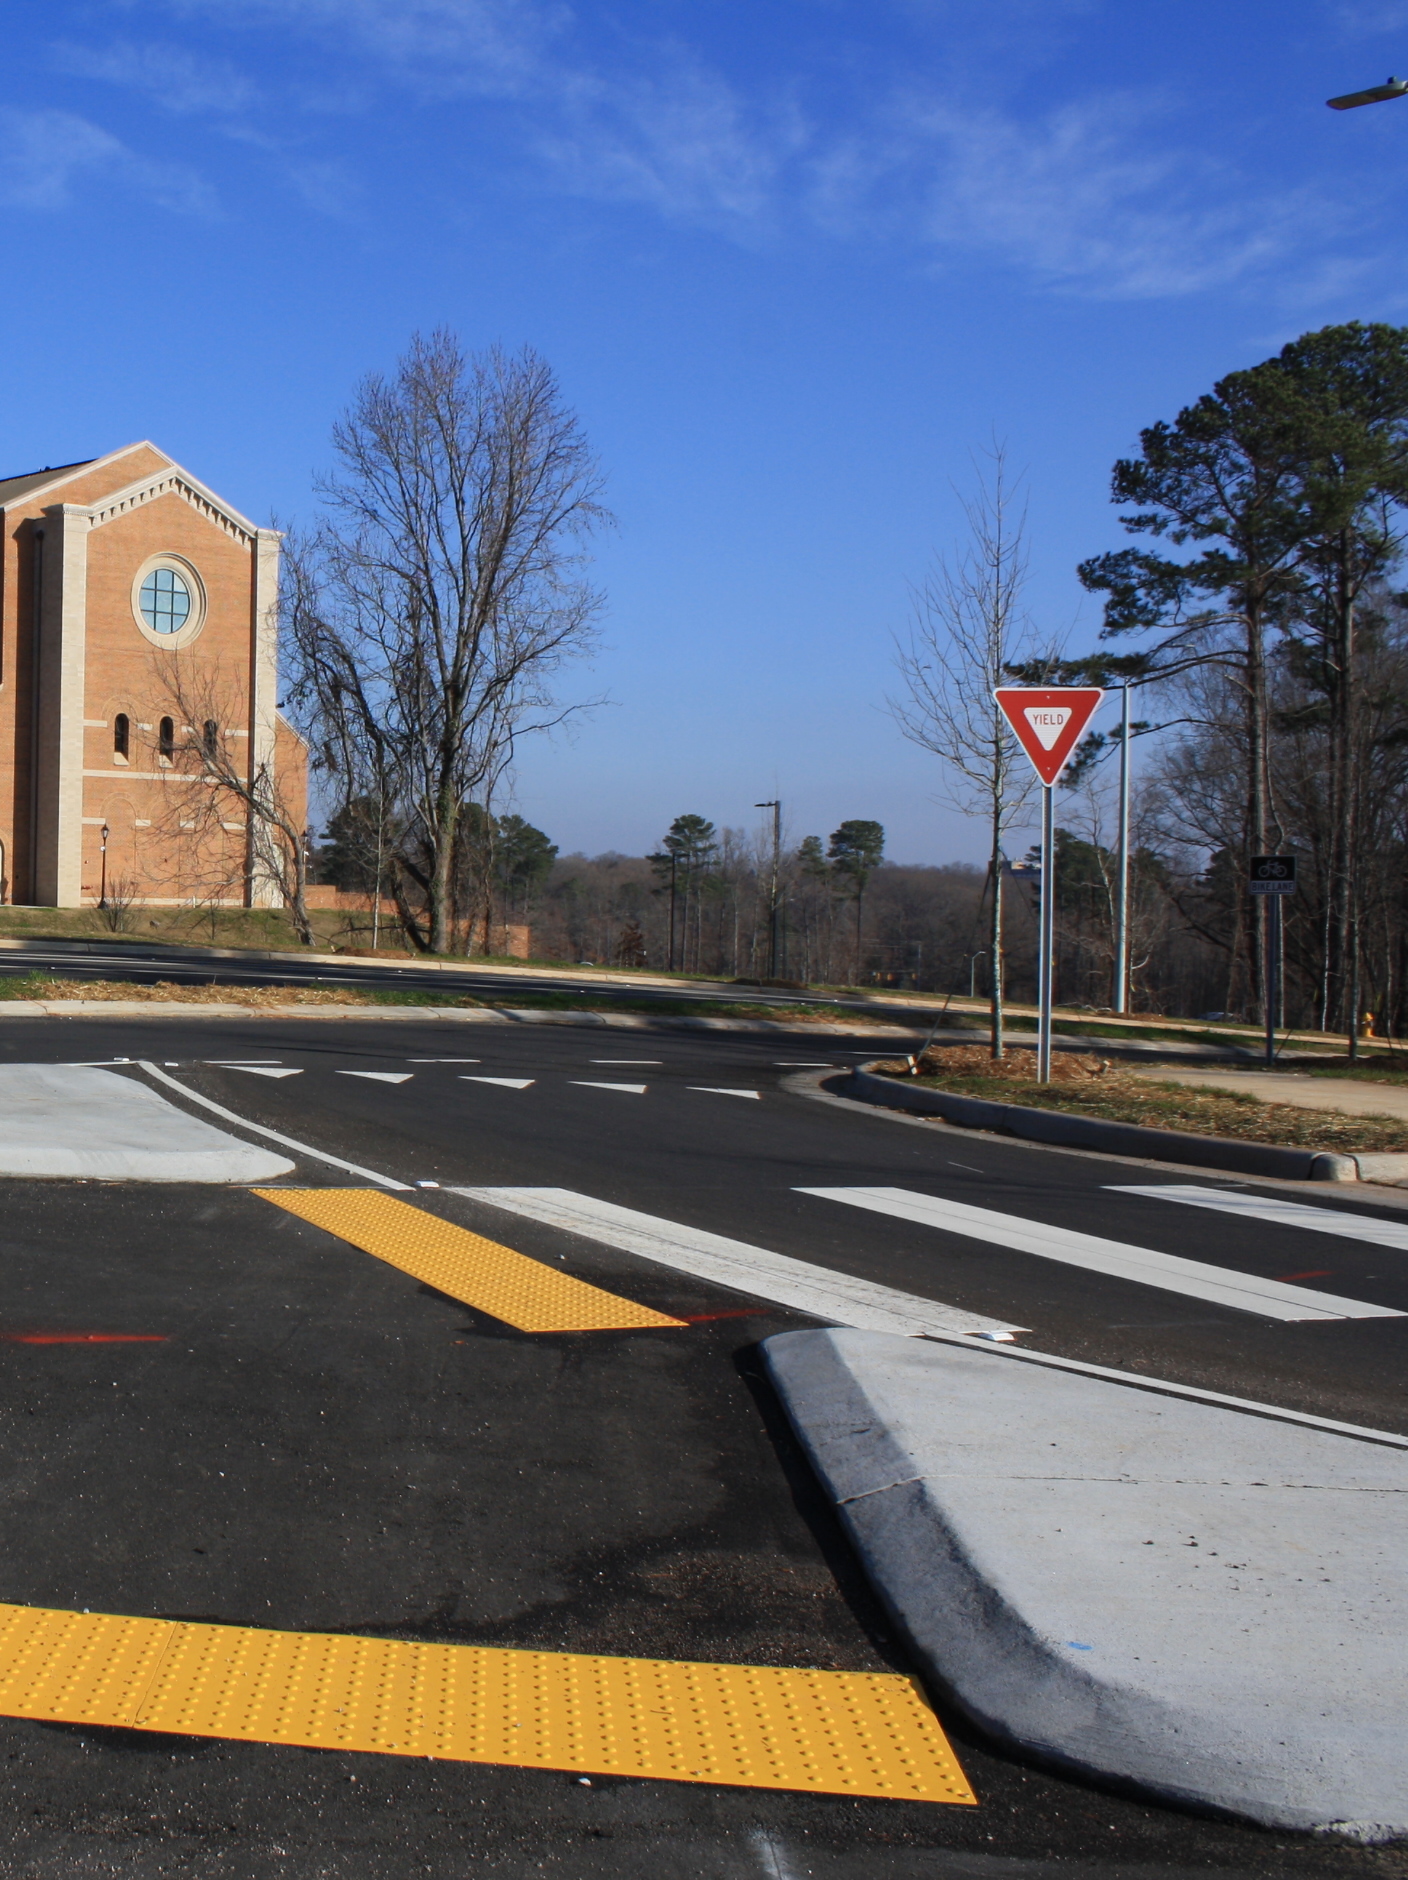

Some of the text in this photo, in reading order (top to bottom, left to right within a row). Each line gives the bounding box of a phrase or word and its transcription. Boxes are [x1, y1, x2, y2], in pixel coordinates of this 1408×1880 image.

[1033, 713, 1064, 725] YIELD
[1252, 882, 1294, 891] BIKE LANE
